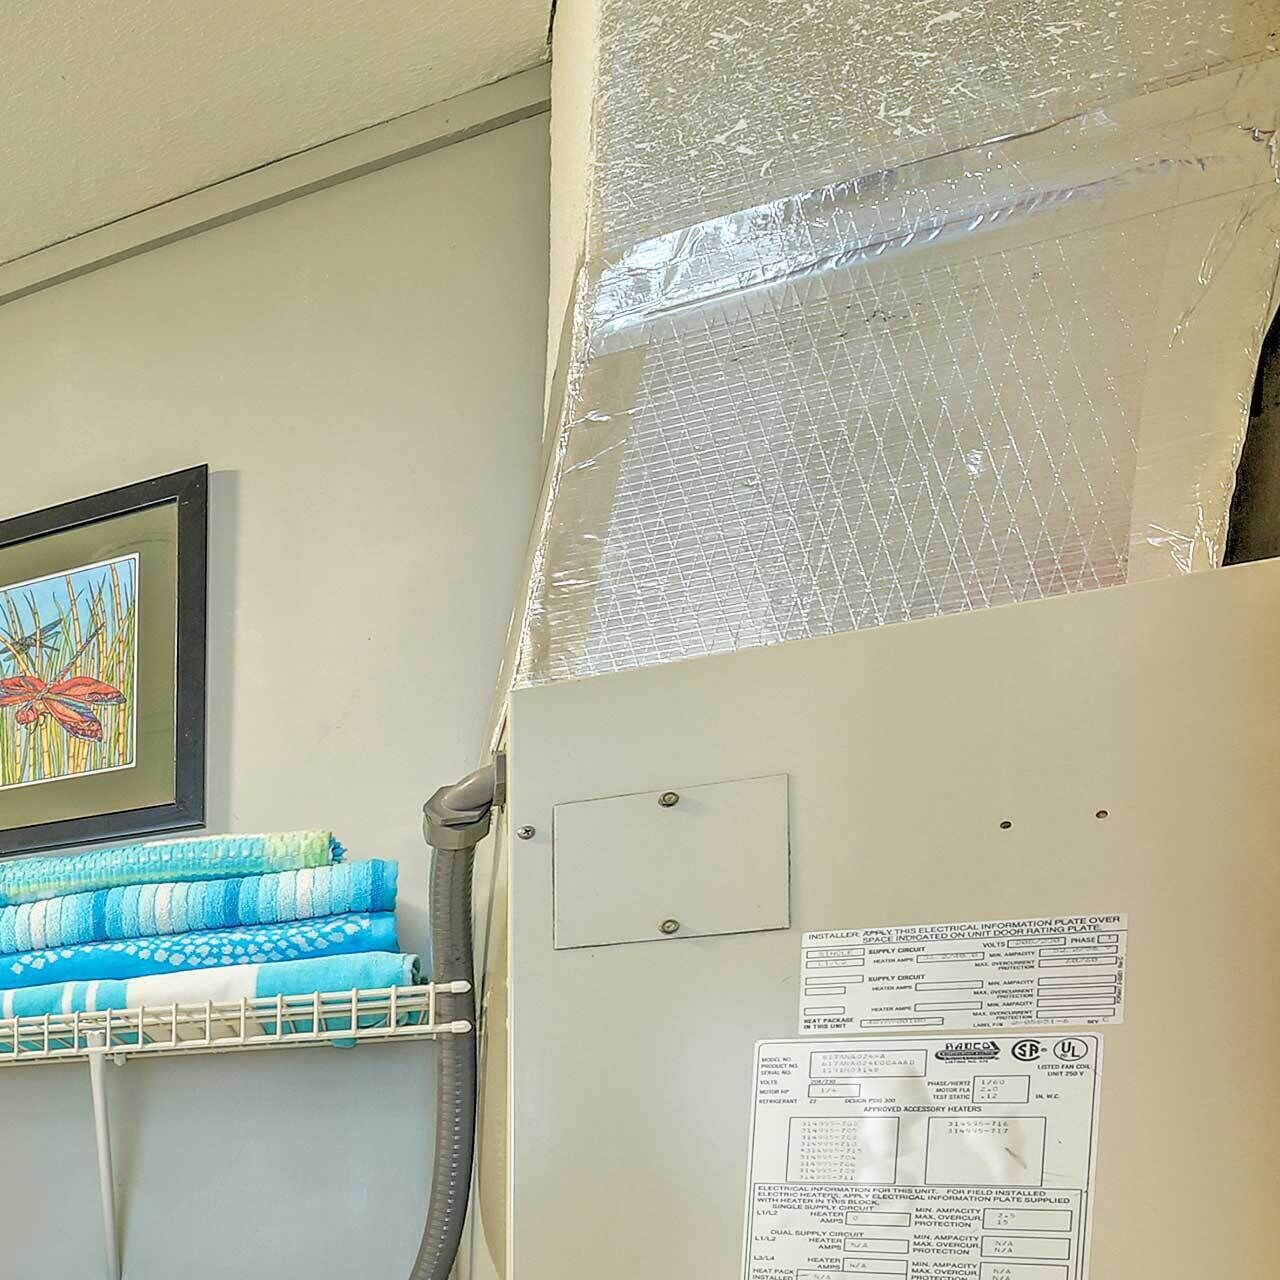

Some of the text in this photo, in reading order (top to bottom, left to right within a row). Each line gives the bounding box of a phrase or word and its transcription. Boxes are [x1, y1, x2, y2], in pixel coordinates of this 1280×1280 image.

[919, 924, 978, 933] ELECTRICAL
[981, 919, 1052, 930] INFORMATION
[896, 932, 947, 941] INDICATED
[1027, 926, 1065, 934] RATING
